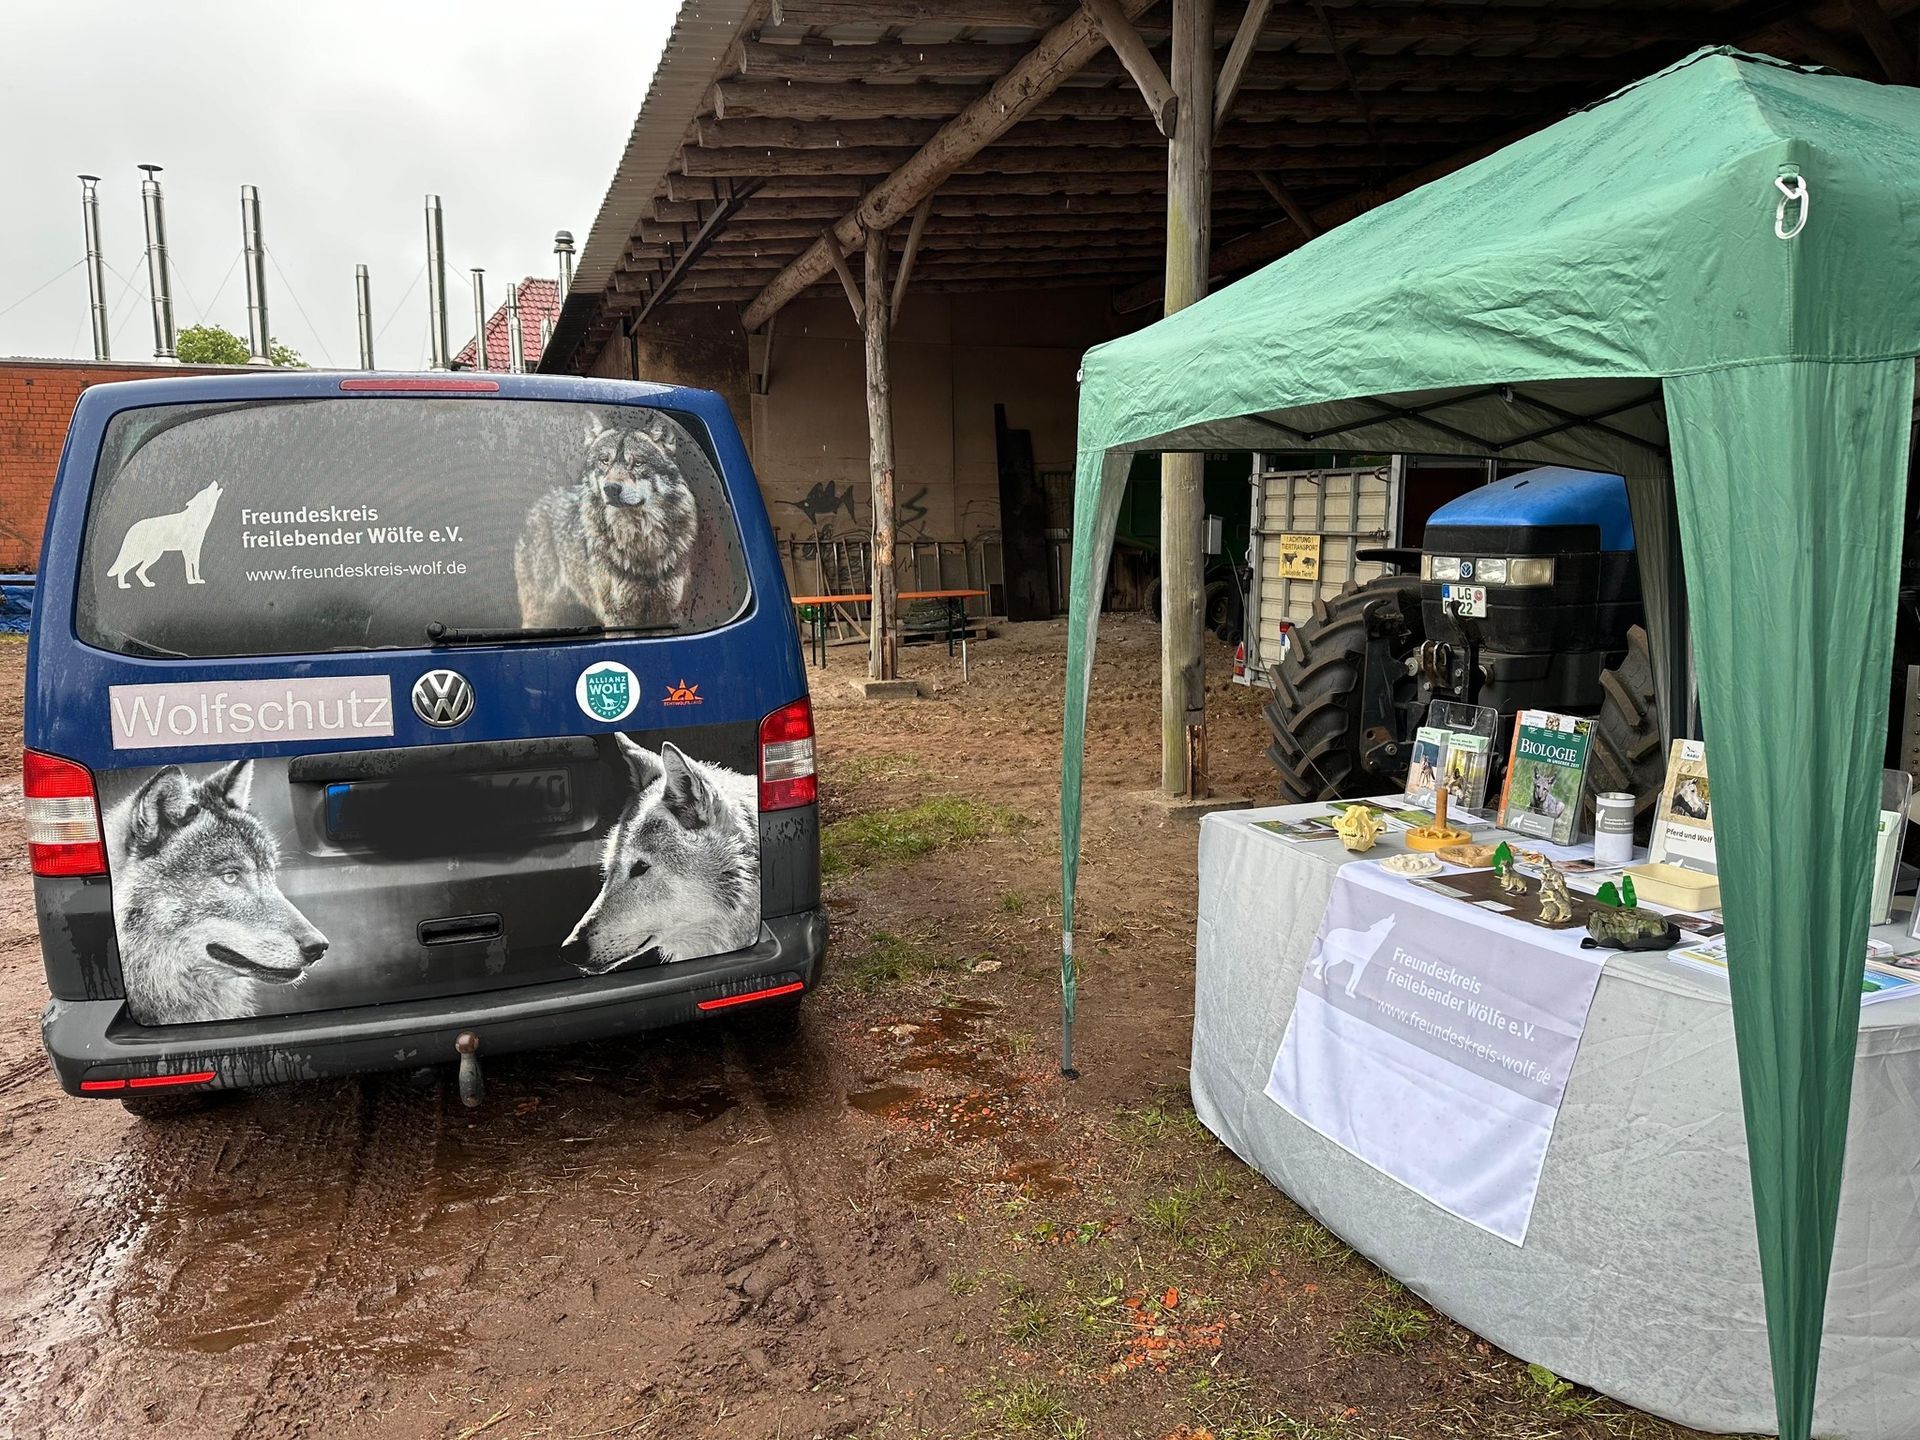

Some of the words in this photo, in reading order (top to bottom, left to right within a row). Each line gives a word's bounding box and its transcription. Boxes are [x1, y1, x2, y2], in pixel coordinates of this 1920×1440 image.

[241, 505, 379, 526] Freundeskreis
[241, 529, 363, 549] freilebender
[367, 526, 424, 545] Wölfe
[428, 526, 464, 543] e.V.
[245, 560, 467, 583] www.freundeskreis-wolf.de
[1457, 587, 1472, 600] LG
[589, 675, 626, 684] ALLIANZ
[589, 683, 627, 695] WOLF
[113, 691, 390, 737] Wolfschutz
[1519, 738, 1577, 762] BIOLOGIE
[1666, 828, 1684, 838] Pferd
[1684, 832, 1696, 841] und
[1697, 834, 1713, 844] Wolf
[1392, 947, 1482, 994] Freundeskreis
[1386, 967, 1465, 1011] freilebender
[1467, 1000, 1506, 1030] Wölfe
[1509, 1022, 1536, 1042] e.V.
[1377, 1000, 1552, 1087] www.freundeskreis-wolf.de
